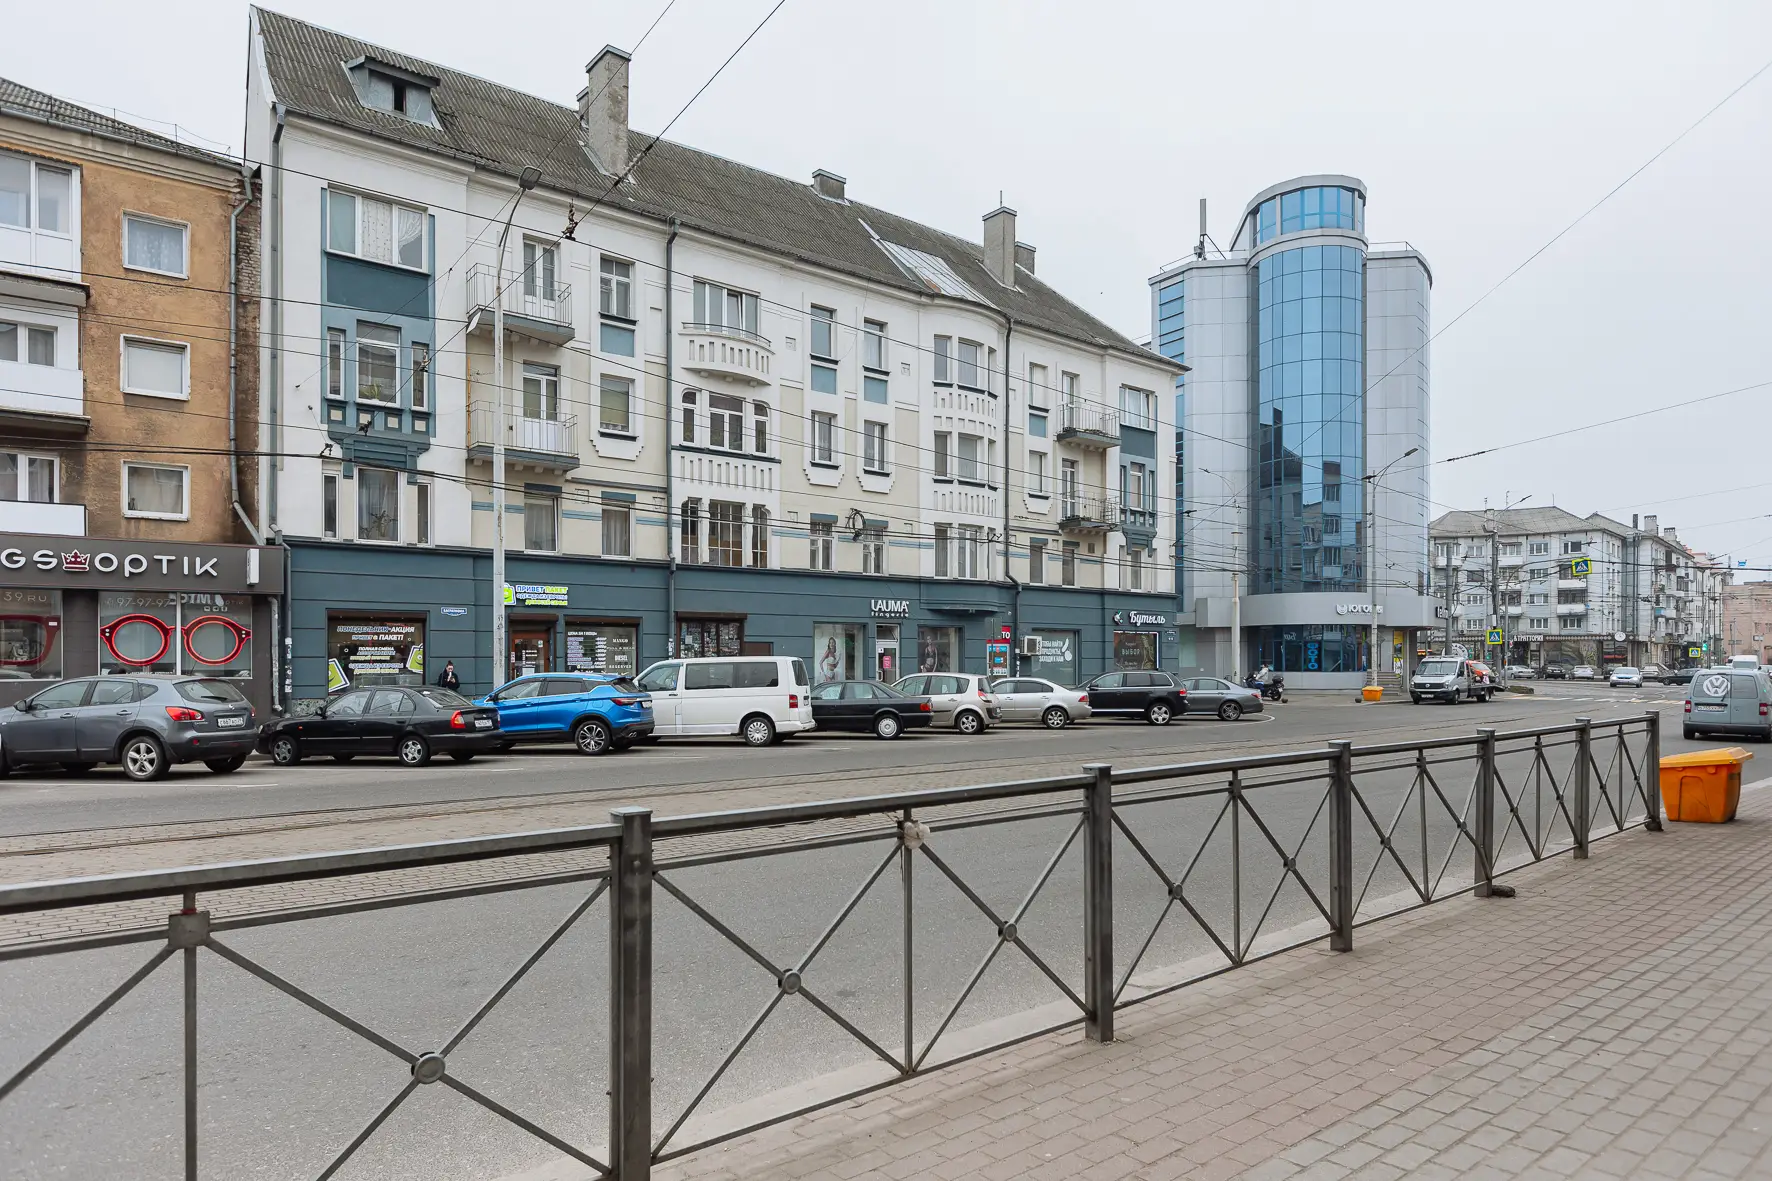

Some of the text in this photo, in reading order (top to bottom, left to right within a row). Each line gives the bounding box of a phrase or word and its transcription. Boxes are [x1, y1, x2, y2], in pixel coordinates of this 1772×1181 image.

[0, 548, 218, 578] GS OPTIK
[516, 585, 545, 593] ПРИВЕТ
[871, 599, 909, 612] LAUMA
[1129, 611, 1166, 627] Бутыль
[1307, 642, 1319, 670] ФОТО
